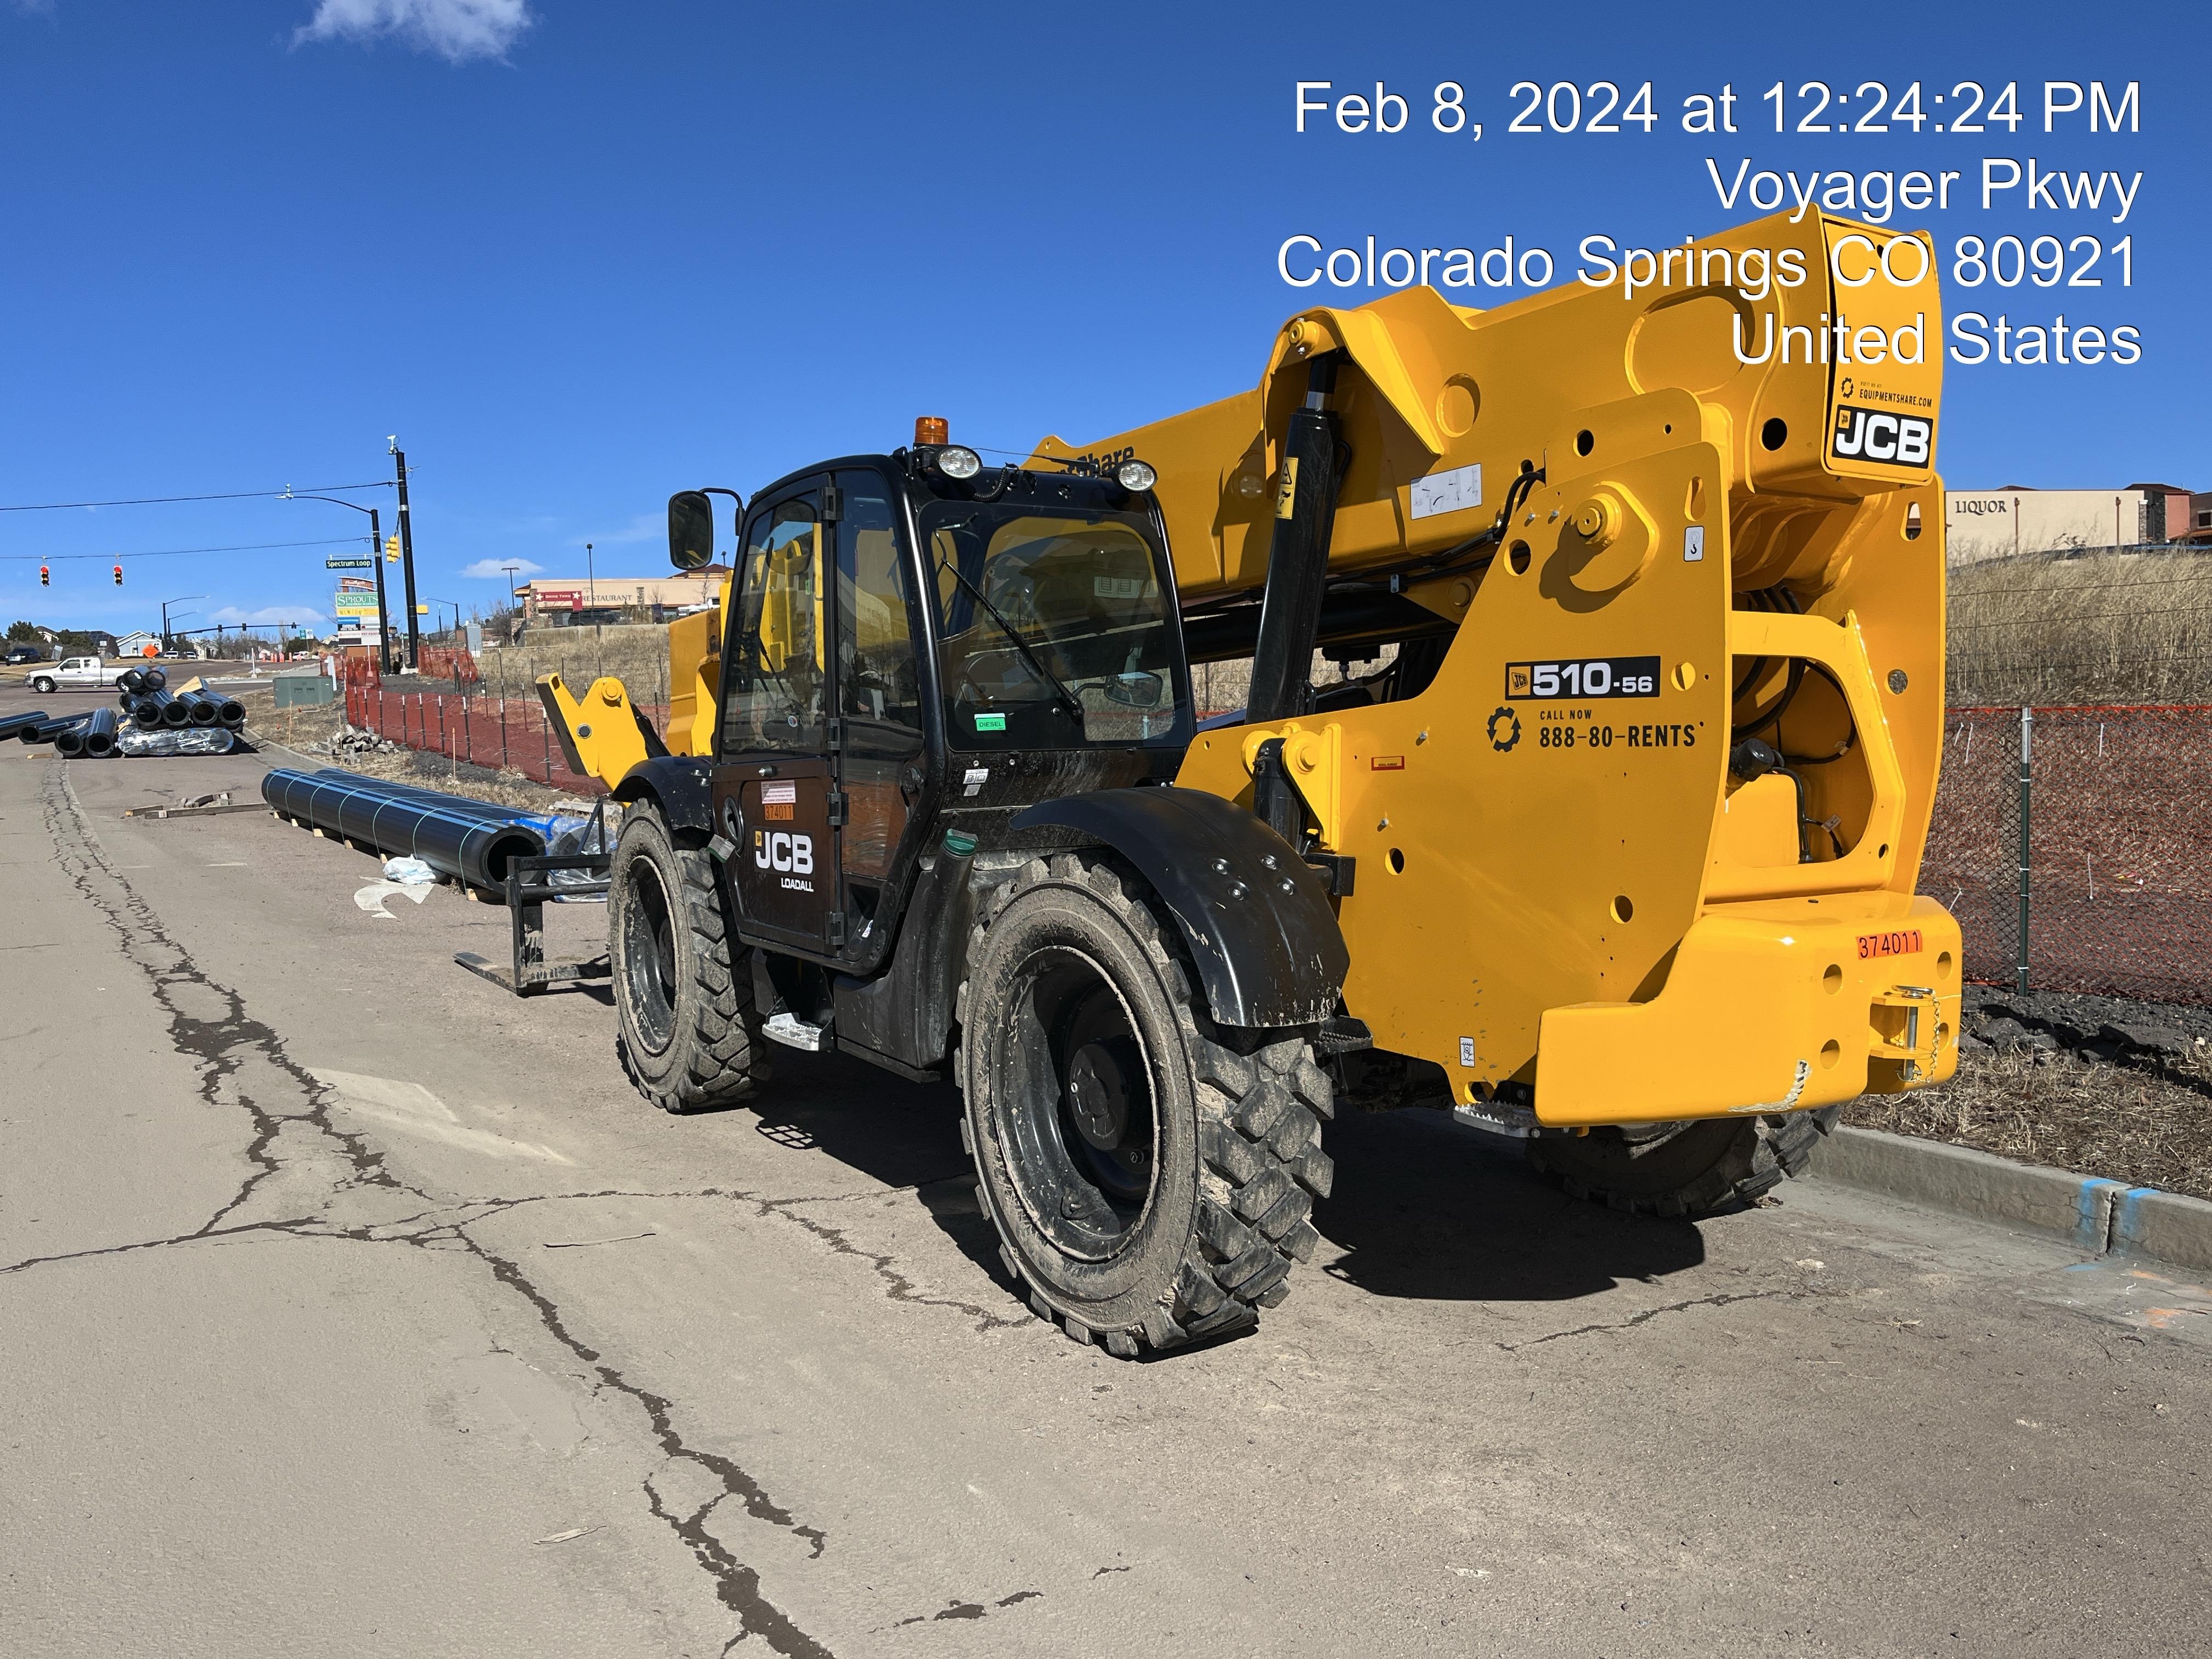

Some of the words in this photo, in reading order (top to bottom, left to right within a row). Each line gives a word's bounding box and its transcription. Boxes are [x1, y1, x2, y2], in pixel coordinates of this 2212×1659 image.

[1860, 389, 1932, 408] EQUIPMENTSHARE.COM
[1836, 412, 1929, 463] JCB
[1955, 500, 2006, 516] LIQUOR
[338, 596, 378, 606] SPROUTS
[1513, 673, 1527, 689] JCB
[1533, 662, 1652, 696] 510-56
[1540, 710, 1564, 720] CALL
[1570, 709, 1592, 720] NOW
[1539, 724, 1695, 748] 888-80-RENTS
[765, 805, 792, 820] 374011
[755, 831, 813, 874] JCB
[781, 877, 814, 892] LOADALL
[1859, 930, 1918, 958] 374011
